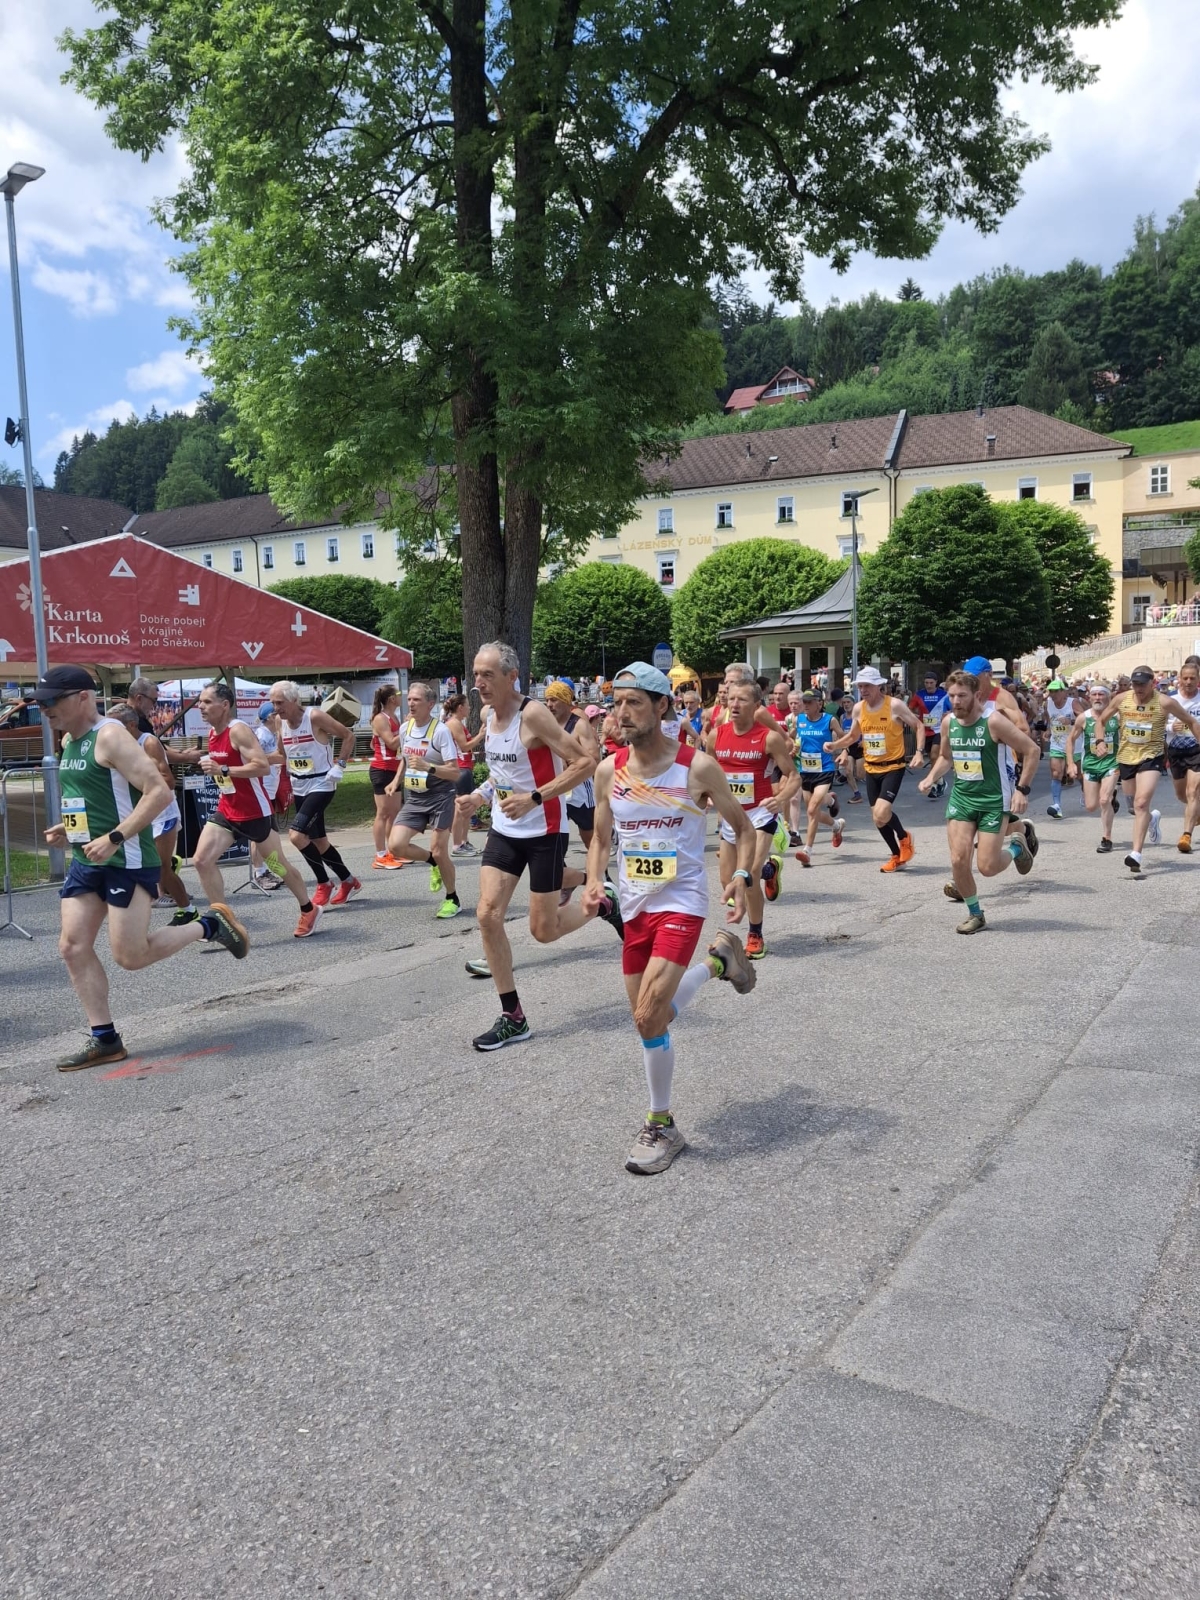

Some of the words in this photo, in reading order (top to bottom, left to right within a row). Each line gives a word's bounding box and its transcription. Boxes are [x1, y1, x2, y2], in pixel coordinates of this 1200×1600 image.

[47, 602, 103, 623] Karta
[140, 614, 170, 624] Dobře
[173, 617, 206, 628] pobejt
[47, 626, 130, 645] Krkonoš
[149, 626, 183, 638] Krajině
[141, 638, 159, 648] pod
[163, 637, 205, 648] Sněžkou
[950, 737, 986, 747] IRELAND
[732, 750, 763, 760] republic
[293, 759, 308, 767] 896
[963, 761, 970, 771] 6
[410, 777, 420, 786] 53
[620, 816, 684, 830] ESPAÑA
[635, 857, 664, 876] 238
